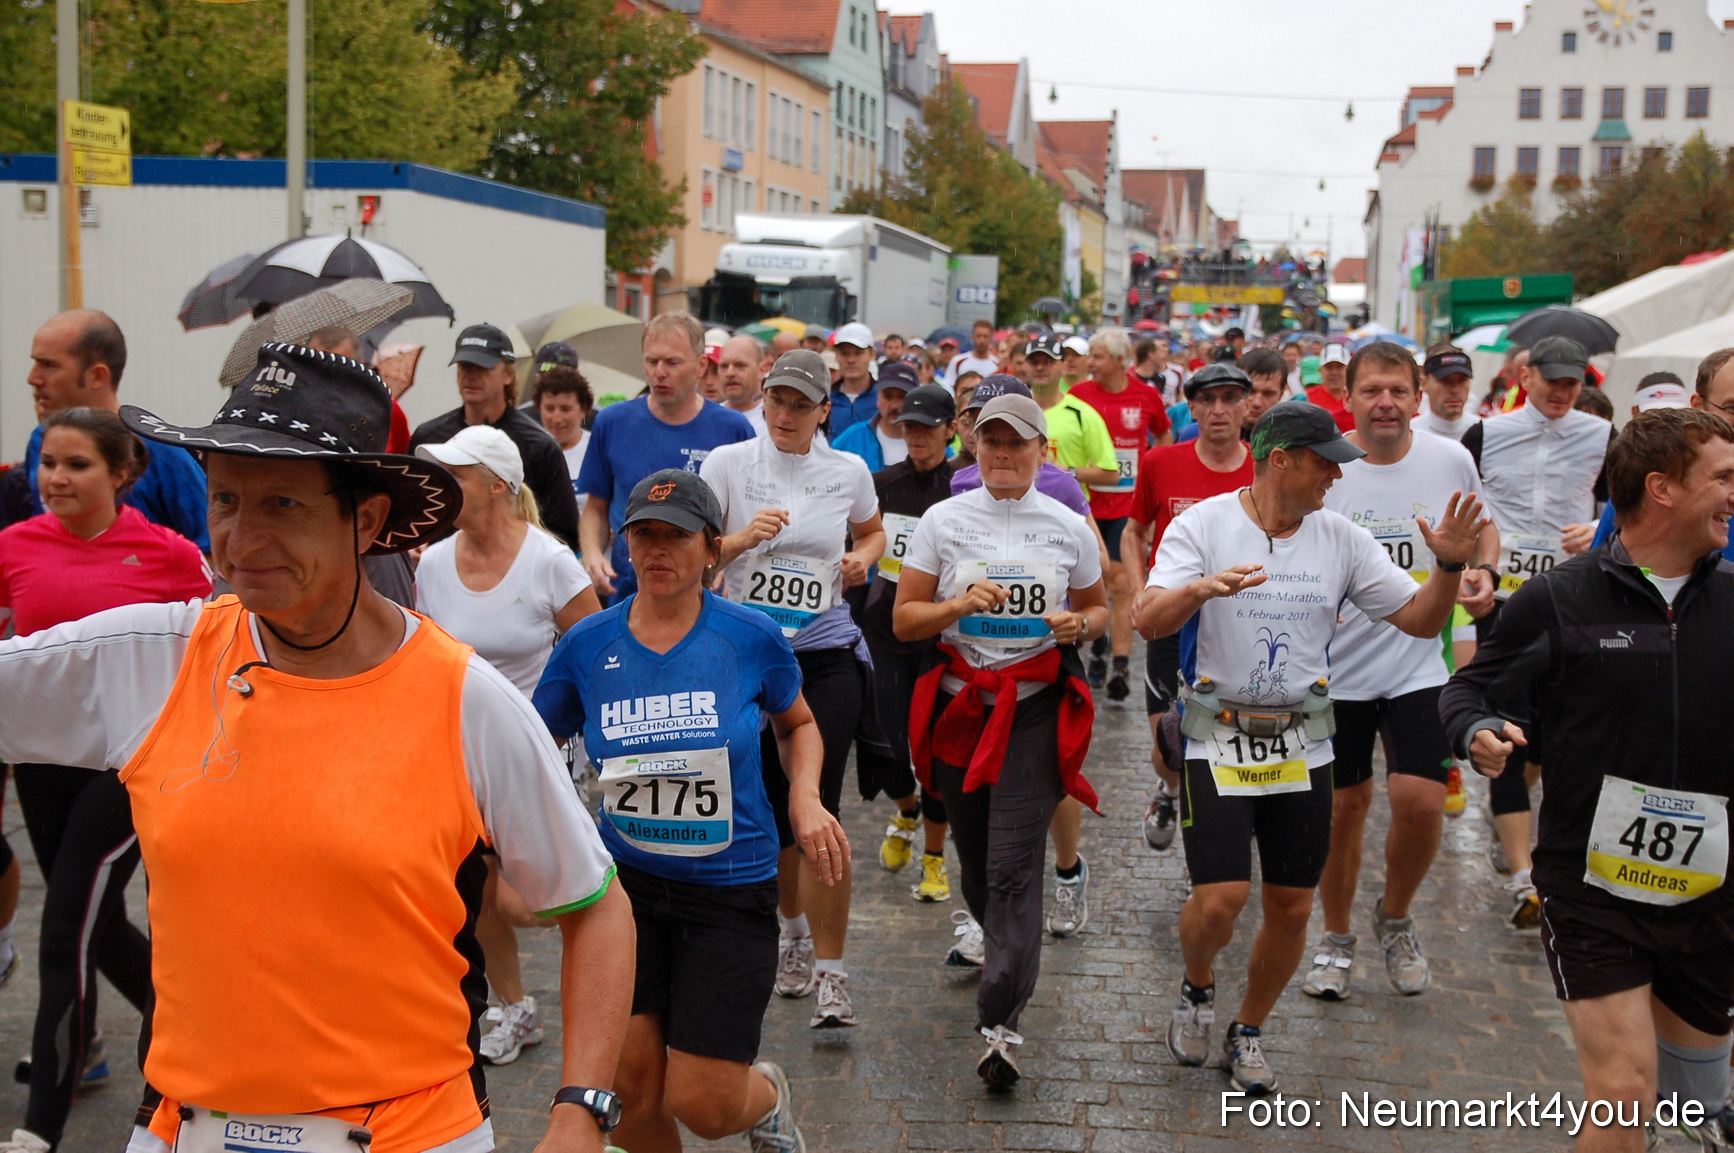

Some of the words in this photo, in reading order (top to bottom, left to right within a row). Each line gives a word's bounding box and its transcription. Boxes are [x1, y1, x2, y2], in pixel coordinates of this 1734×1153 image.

[256, 361, 296, 386] riu
[250, 384, 280, 394] Palace
[805, 483, 841, 496] Mobil
[744, 493, 782, 505] TRIATHLON
[966, 529, 991, 537] JAHRE
[1024, 533, 1064, 546] Mobil
[952, 540, 997, 551] TRIATHLON
[771, 557, 808, 570] BOCK
[986, 565, 1025, 575] BOCK
[1508, 551, 1555, 576] 540
[749, 571, 822, 609] 2899
[1222, 590, 1328, 604] ermen-Marathon
[966, 583, 1046, 615] 98
[761, 609, 807, 626] ristine
[1237, 610, 1246, 618] 6.
[1248, 610, 1284, 620] Februar
[1287, 612, 1310, 621] 2011
[981, 621, 1029, 635] Daniela
[601, 691, 718, 728] HUBER
[622, 716, 713, 734] TECHNOLOGY
[622, 735, 650, 747] WASTE
[651, 732, 680, 742] WATER
[682, 730, 716, 739] Solutions
[1227, 732, 1289, 764] 164
[638, 758, 688, 772] BOCK
[1237, 769, 1282, 783] Werner
[616, 778, 719, 817] 2175
[1642, 794, 1695, 811] BOCK
[627, 821, 707, 841] Alexandra
[1618, 816, 1704, 867] 487
[1616, 864, 1689, 892] Andreas
[224, 1120, 303, 1145] BOCK
